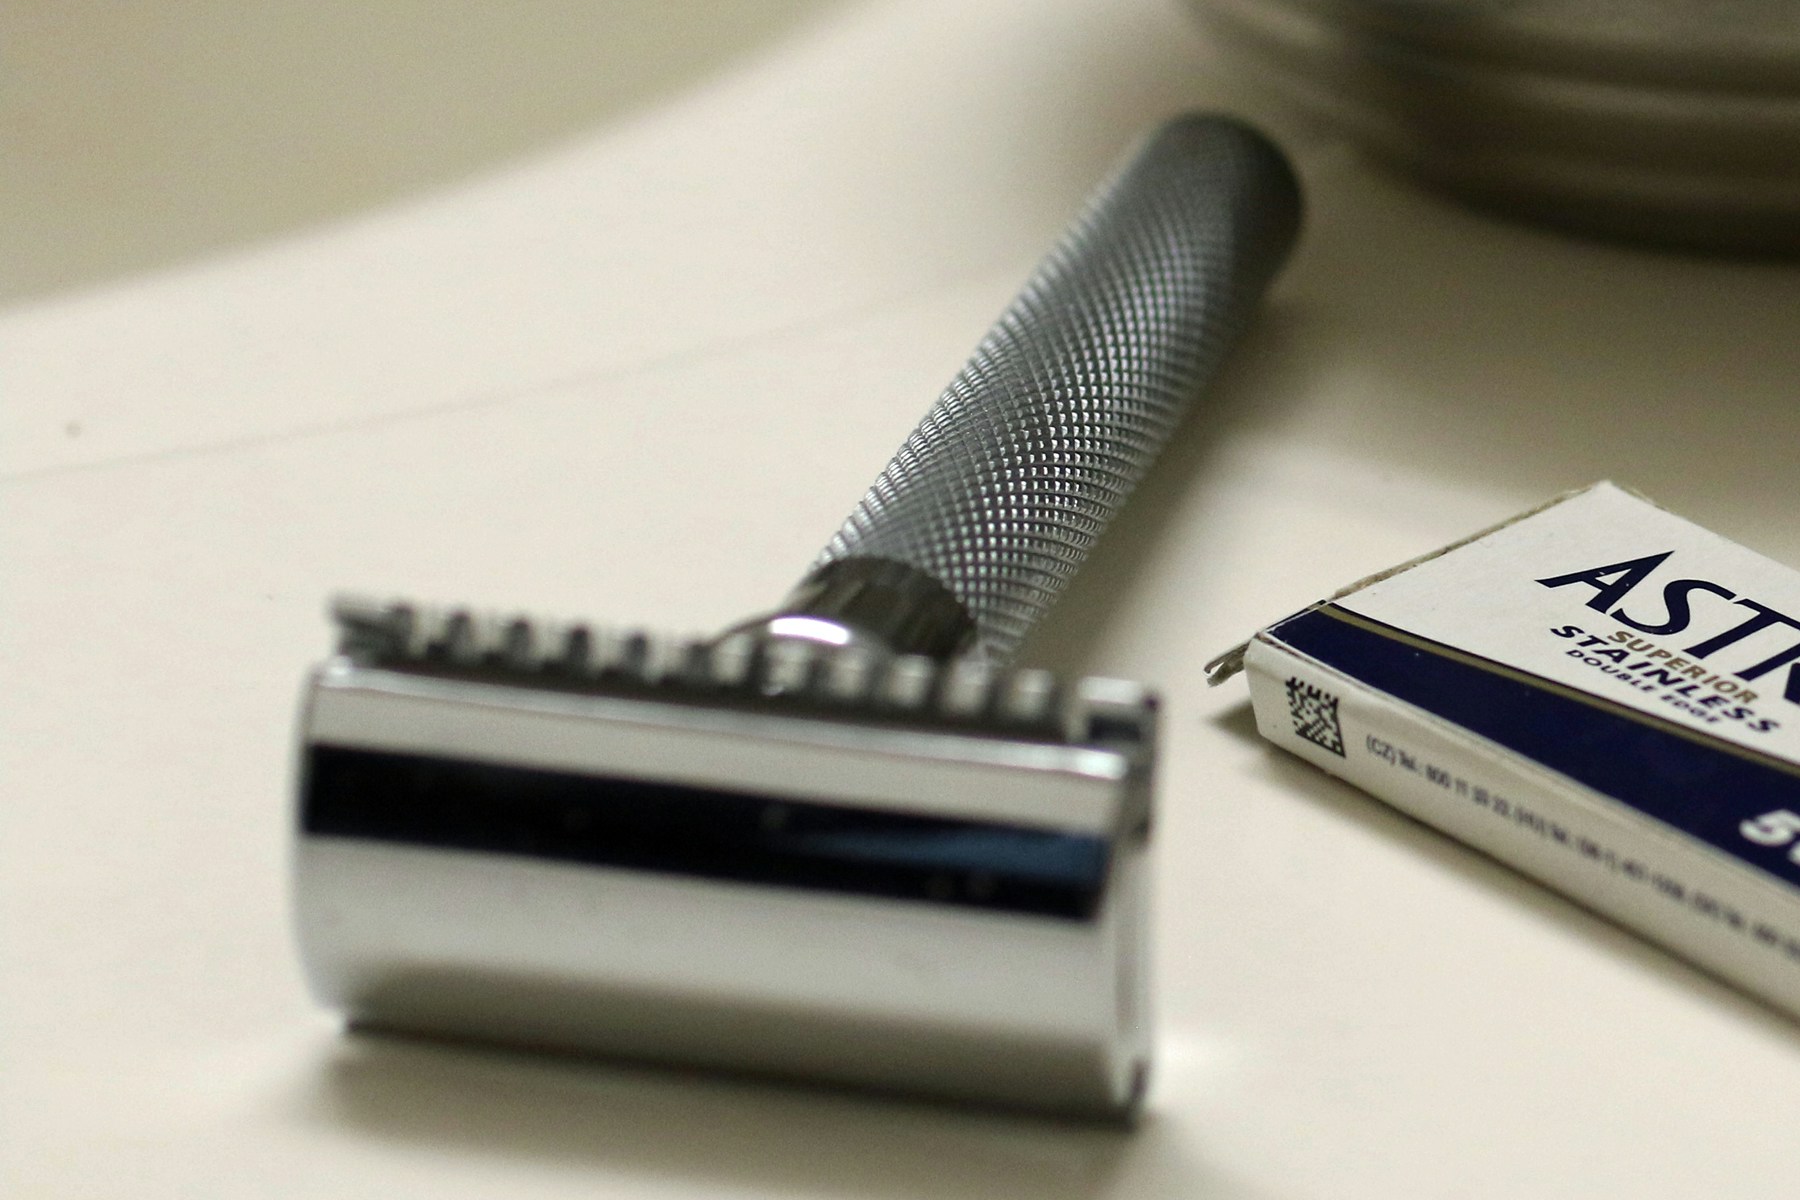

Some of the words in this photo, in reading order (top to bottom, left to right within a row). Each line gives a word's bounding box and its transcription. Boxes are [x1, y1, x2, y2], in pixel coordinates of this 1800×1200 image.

[1550, 625, 1781, 733] STAINLESS
[1565, 650, 1658, 693] DOUBLE
[1660, 693, 1721, 724] EDGE
[1607, 630, 1760, 705] SUPERIOR
